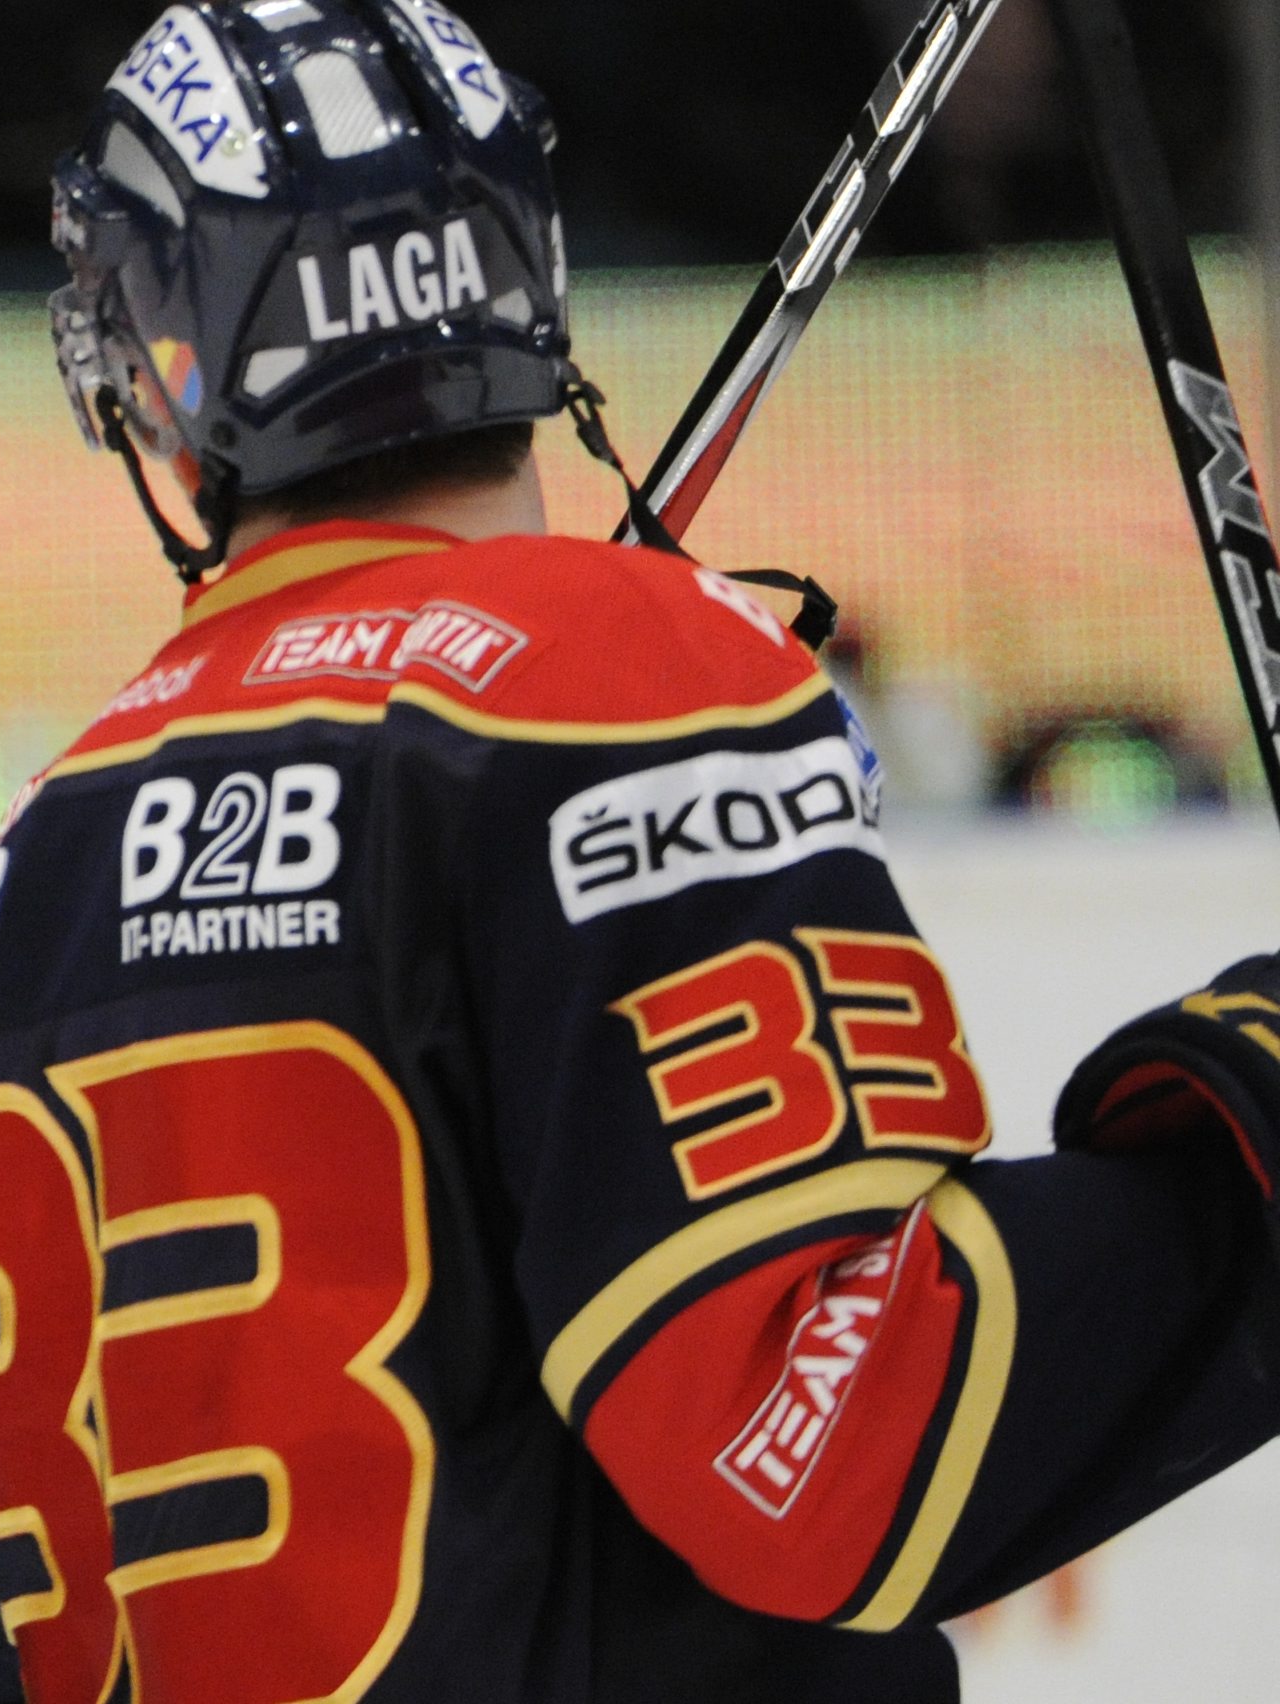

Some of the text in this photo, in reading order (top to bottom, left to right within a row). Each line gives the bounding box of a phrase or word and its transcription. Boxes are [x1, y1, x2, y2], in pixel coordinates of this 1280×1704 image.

[297, 218, 487, 343] LAGA
[261, 619, 393, 674] TEAM
[121, 763, 341, 909] B2B
[122, 900, 340, 964] IT-PARTNER
[604, 926, 993, 1200] 33
[735, 1294, 883, 1488] TEAM
